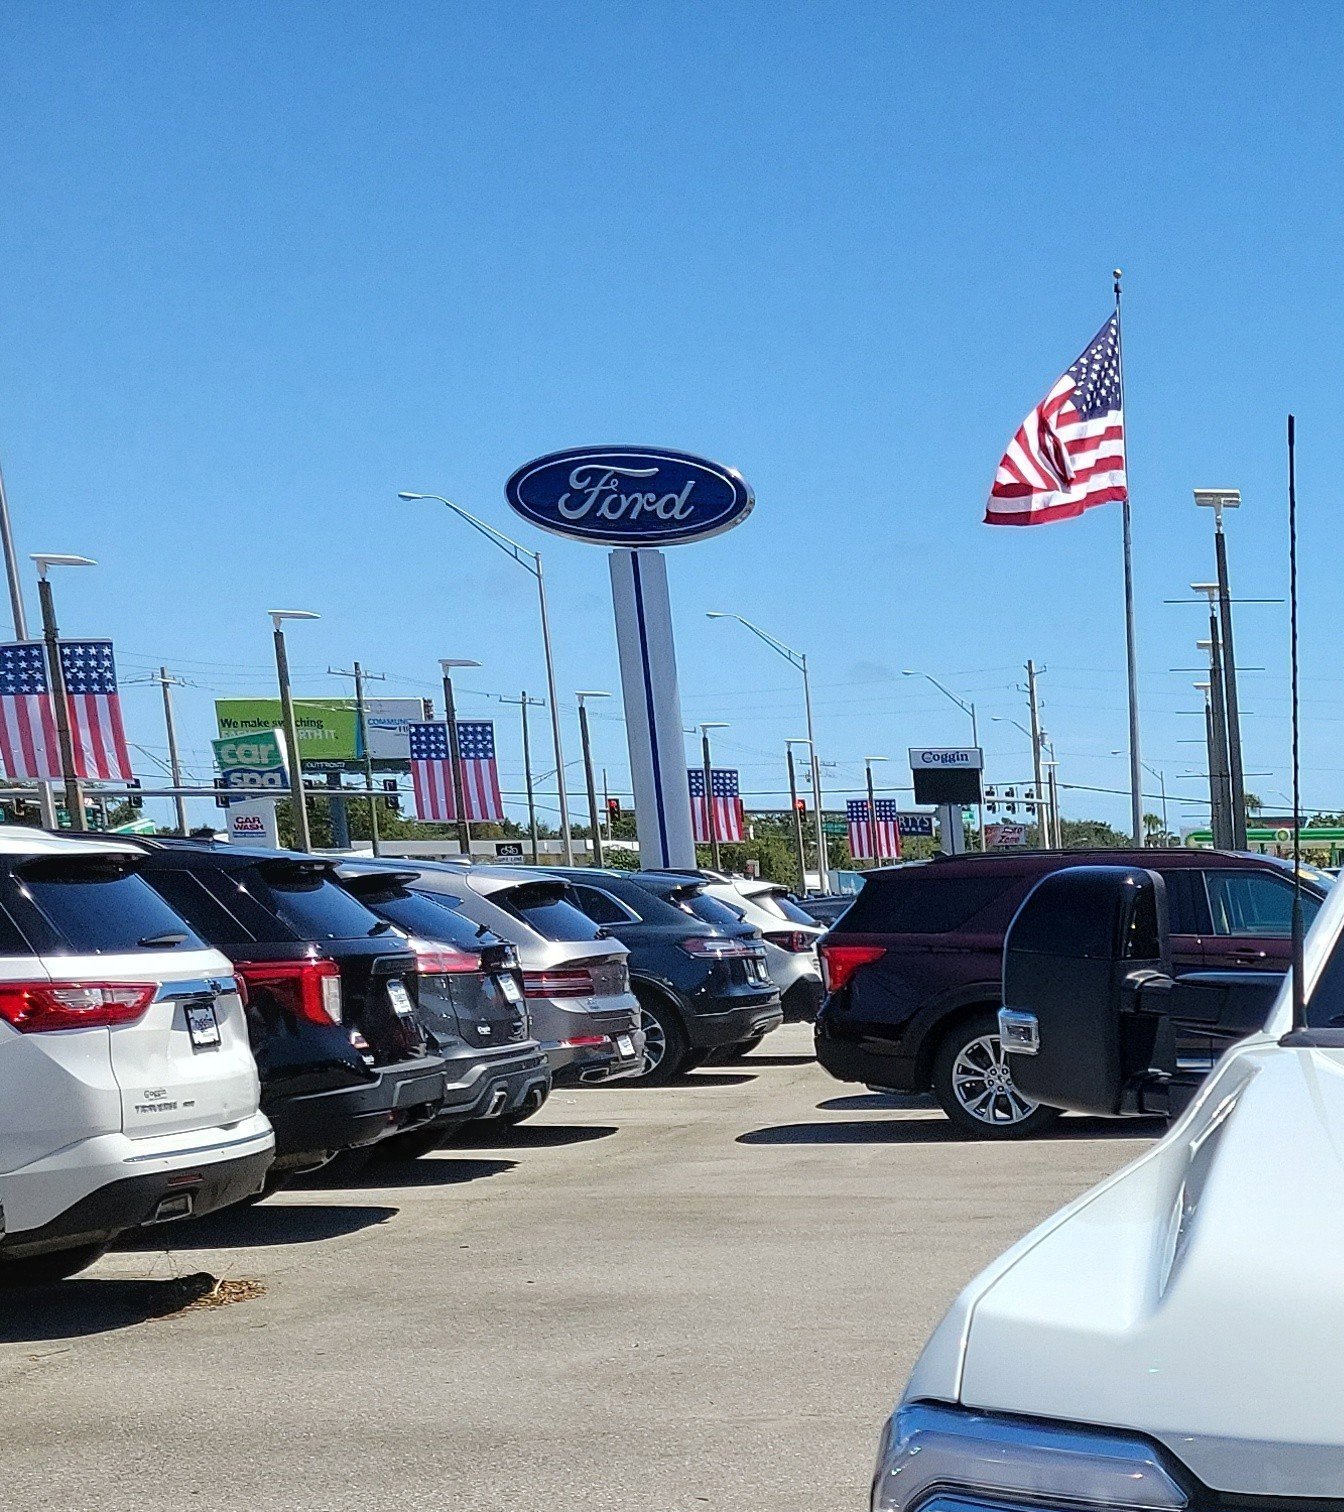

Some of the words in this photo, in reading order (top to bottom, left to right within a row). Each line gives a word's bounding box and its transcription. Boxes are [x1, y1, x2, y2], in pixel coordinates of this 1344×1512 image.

[558, 464, 696, 520] Ford
[220, 718, 239, 729] We
[240, 717, 270, 728] make
[272, 717, 324, 730] swching
[221, 743, 276, 766] car
[921, 751, 970, 764] Coggin
[229, 772, 282, 788] spa
[235, 816, 261, 824] CAR
[898, 815, 930, 827] RTYS
